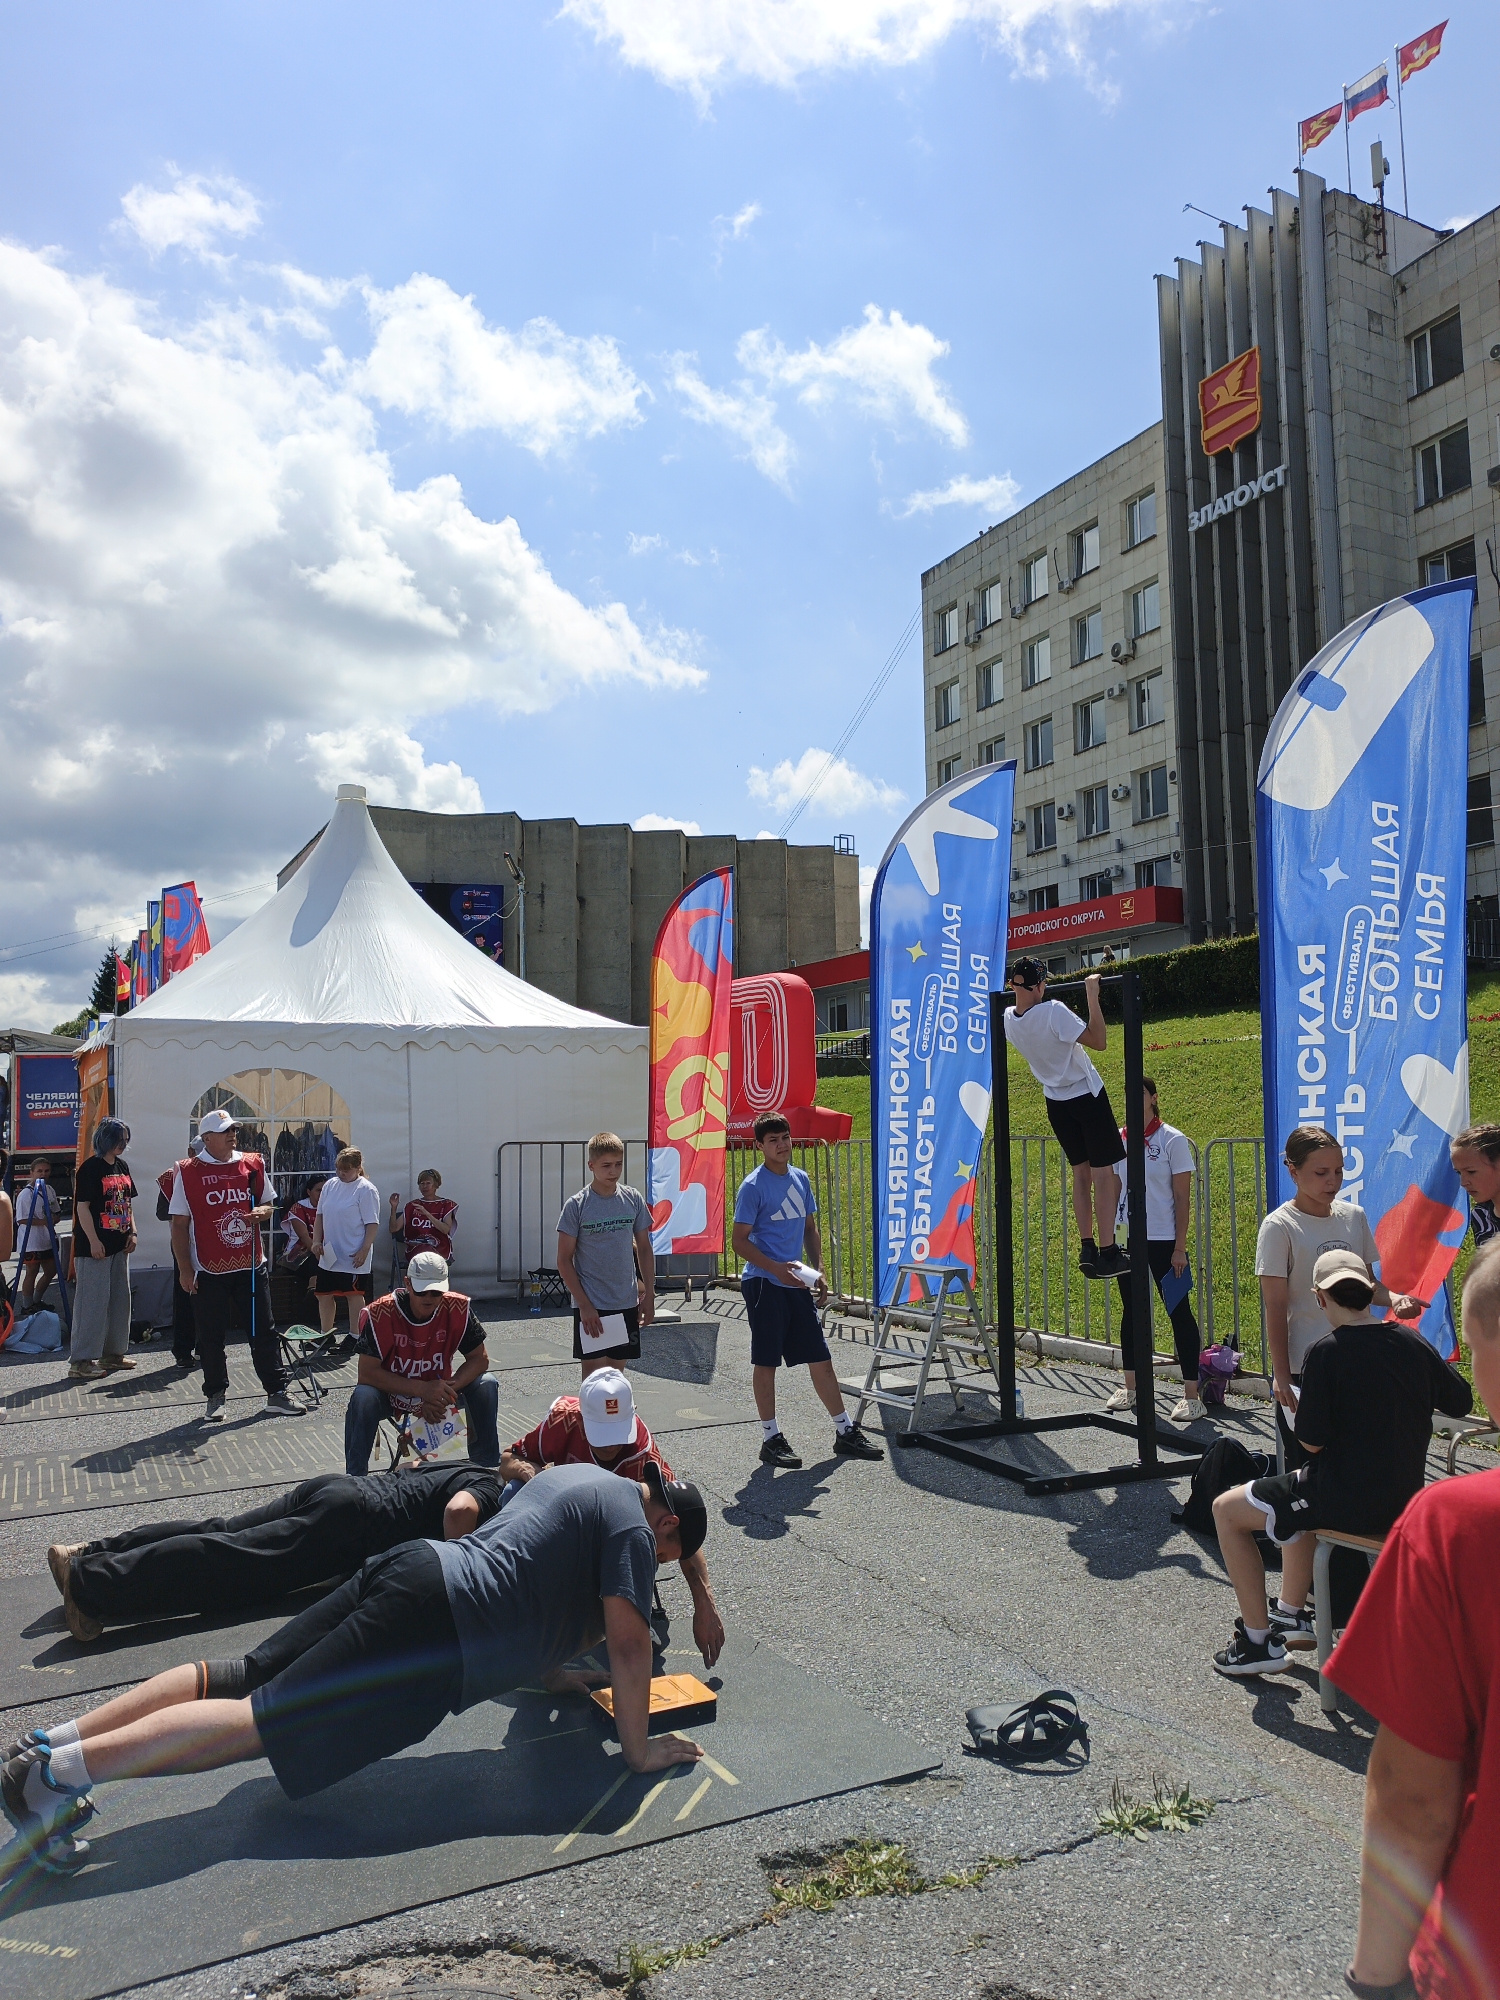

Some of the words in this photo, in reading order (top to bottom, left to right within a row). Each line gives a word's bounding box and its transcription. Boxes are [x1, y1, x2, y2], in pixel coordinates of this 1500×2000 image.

[1187, 463, 1288, 532] ЗЛАТОУСТ
[1014, 916, 1069, 938] ГОРОДСКОГО
[1071, 909, 1105, 926] ОКРУГА
[1368, 800, 1400, 1021] БОЛЬШАЯ
[1414, 872, 1446, 1021] СЕМЬЯ
[922, 983, 938, 1052] ФЕСТИВАЛЬ
[939, 903, 962, 1053] БОЛЬШАЯ
[967, 953, 990, 1054] СЕМЬЯ
[1342, 919, 1366, 1019] ФЕСТИВАЛЬ
[202, 1174, 219, 1186] ГТО
[887, 998, 911, 1265] ЧЕЛЯБИНСКАЯ
[911, 1095, 936, 1262] ОБЛАСТЬ
[1335, 1083, 1366, 1206] АСТЬ
[205, 1187, 252, 1206] СУДЬЯ
[411, 1217, 435, 1229] СУД
[394, 1333, 408, 1348] ТО
